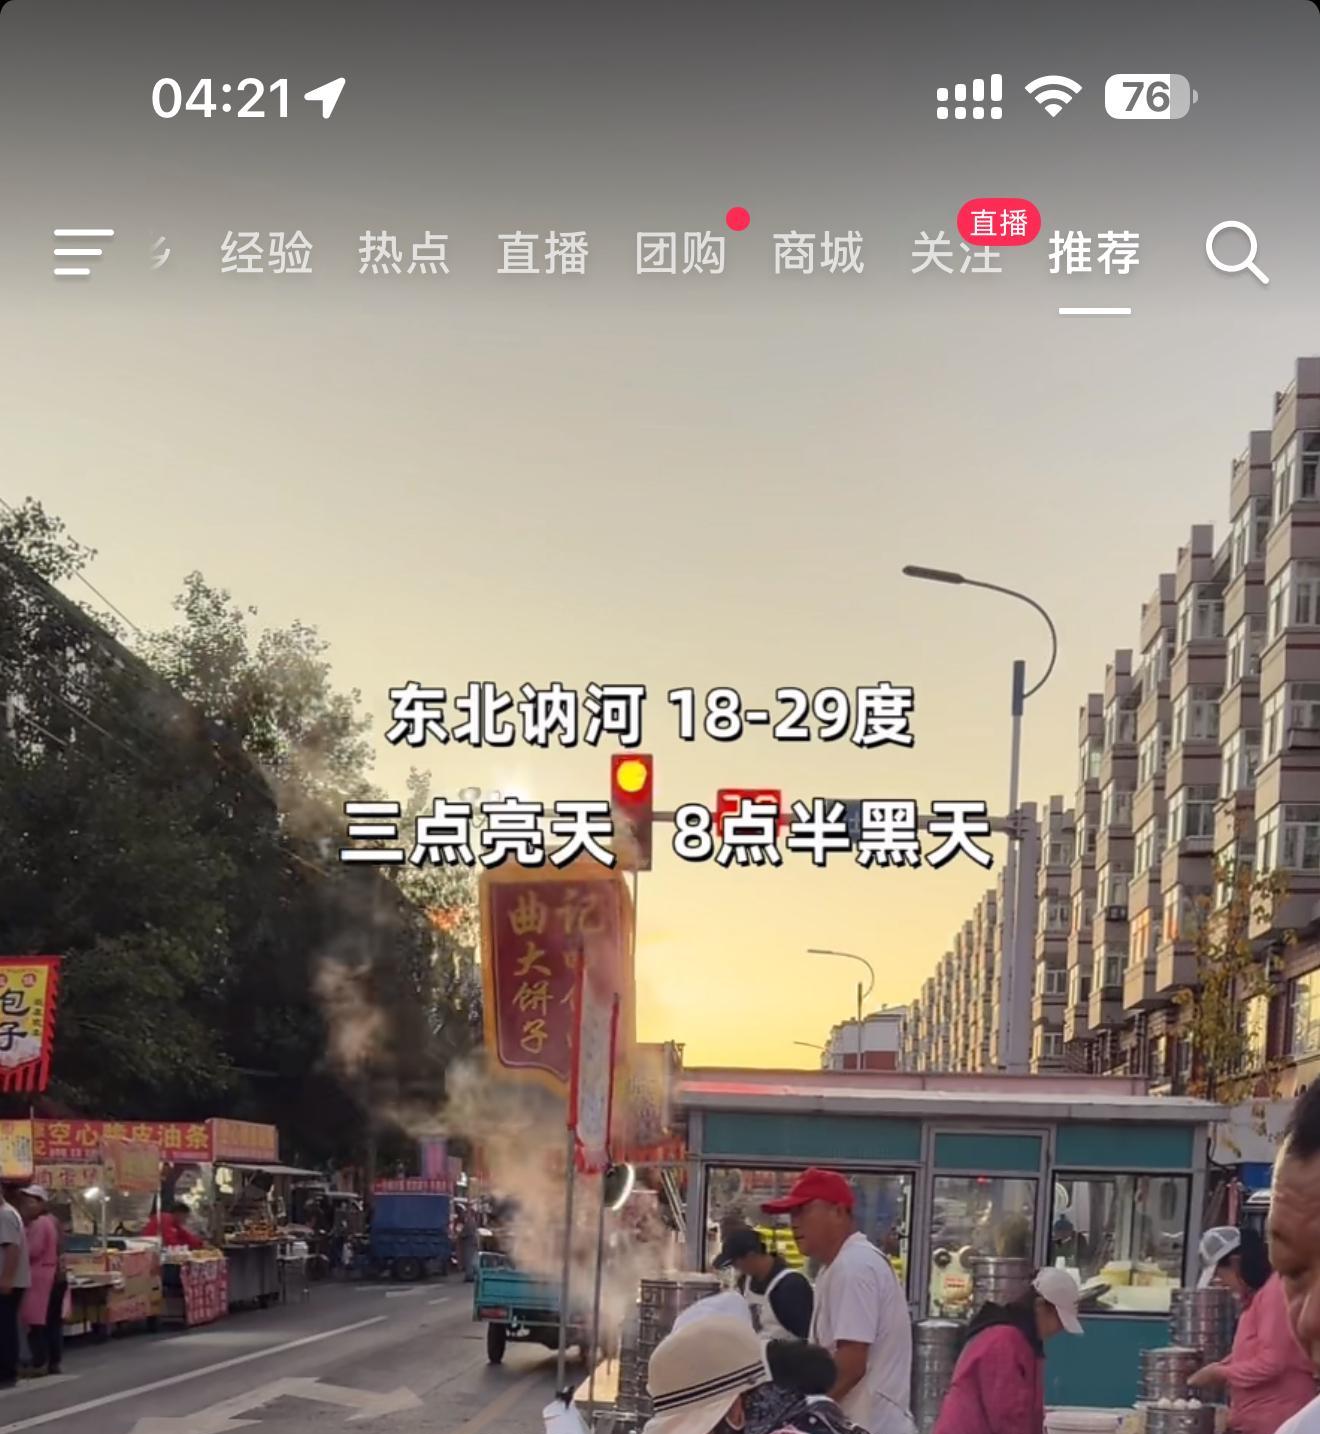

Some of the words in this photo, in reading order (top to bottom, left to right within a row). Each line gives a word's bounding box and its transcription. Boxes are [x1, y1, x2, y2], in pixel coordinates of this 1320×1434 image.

[0, 988, 30, 1051] 包子
[507, 889, 555, 1056] 曲大饼子
